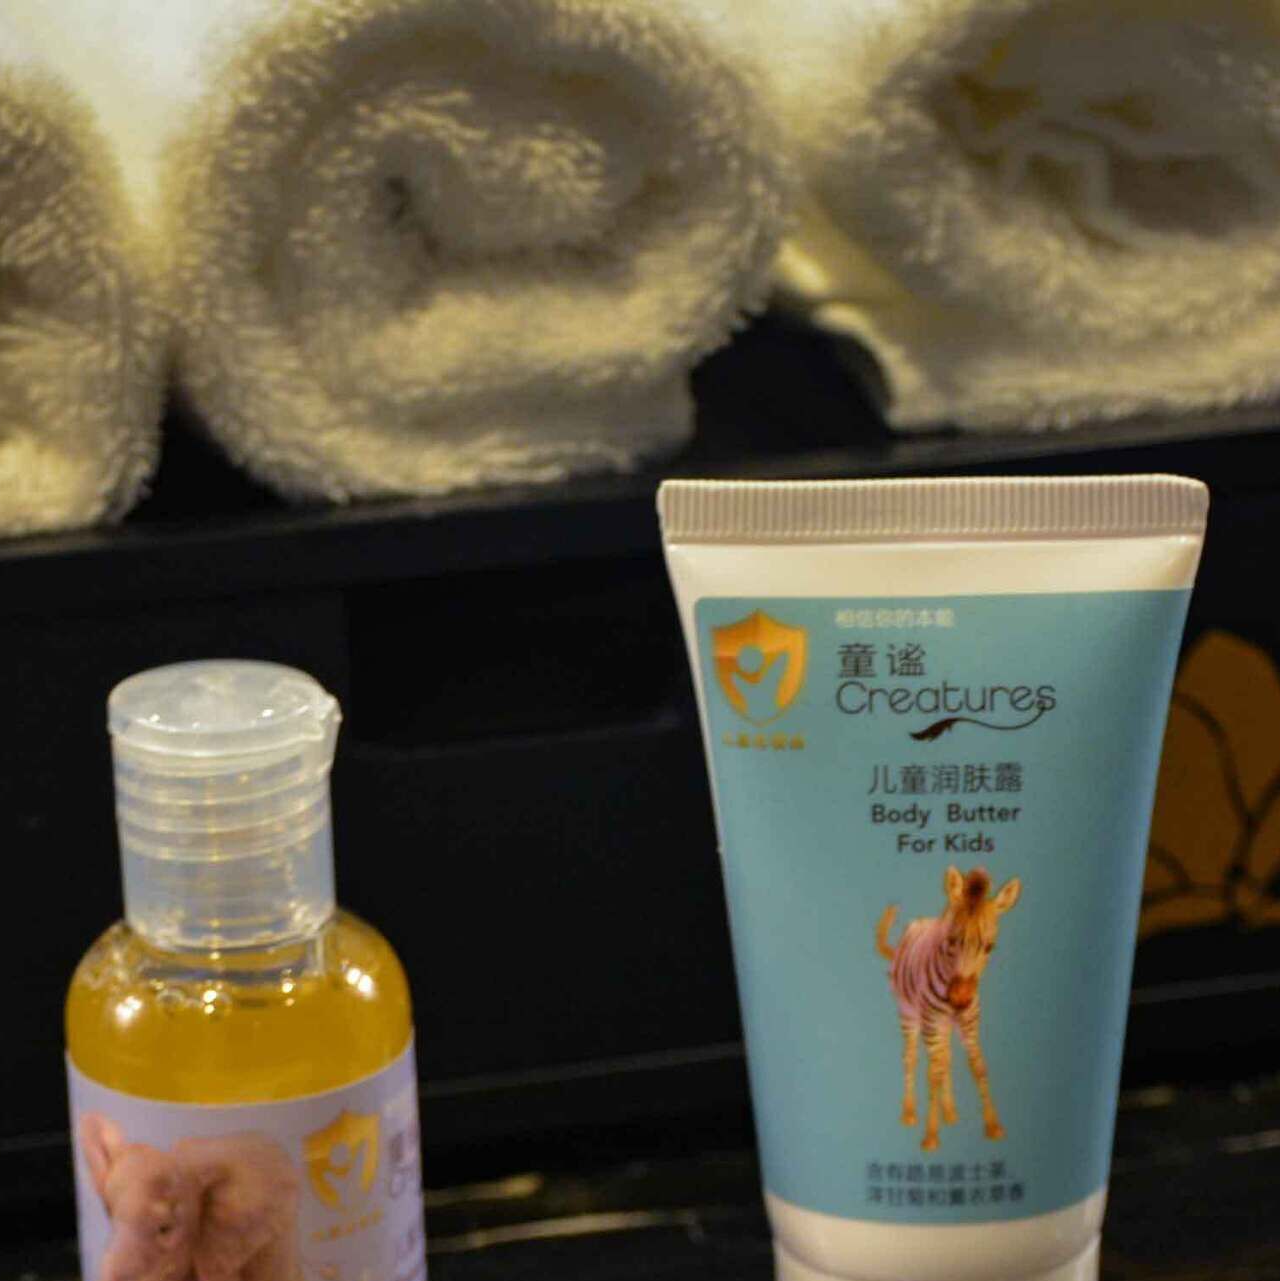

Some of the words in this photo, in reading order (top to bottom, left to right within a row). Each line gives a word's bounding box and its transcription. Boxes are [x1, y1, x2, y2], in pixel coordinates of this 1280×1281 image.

[834, 680, 1058, 715] Creatures
[868, 762, 1026, 796] 儿童润肤露
[871, 803, 931, 829] Body
[946, 802, 1022, 824] Butter
[896, 833, 936, 854] For
[943, 830, 995, 854] Kids
